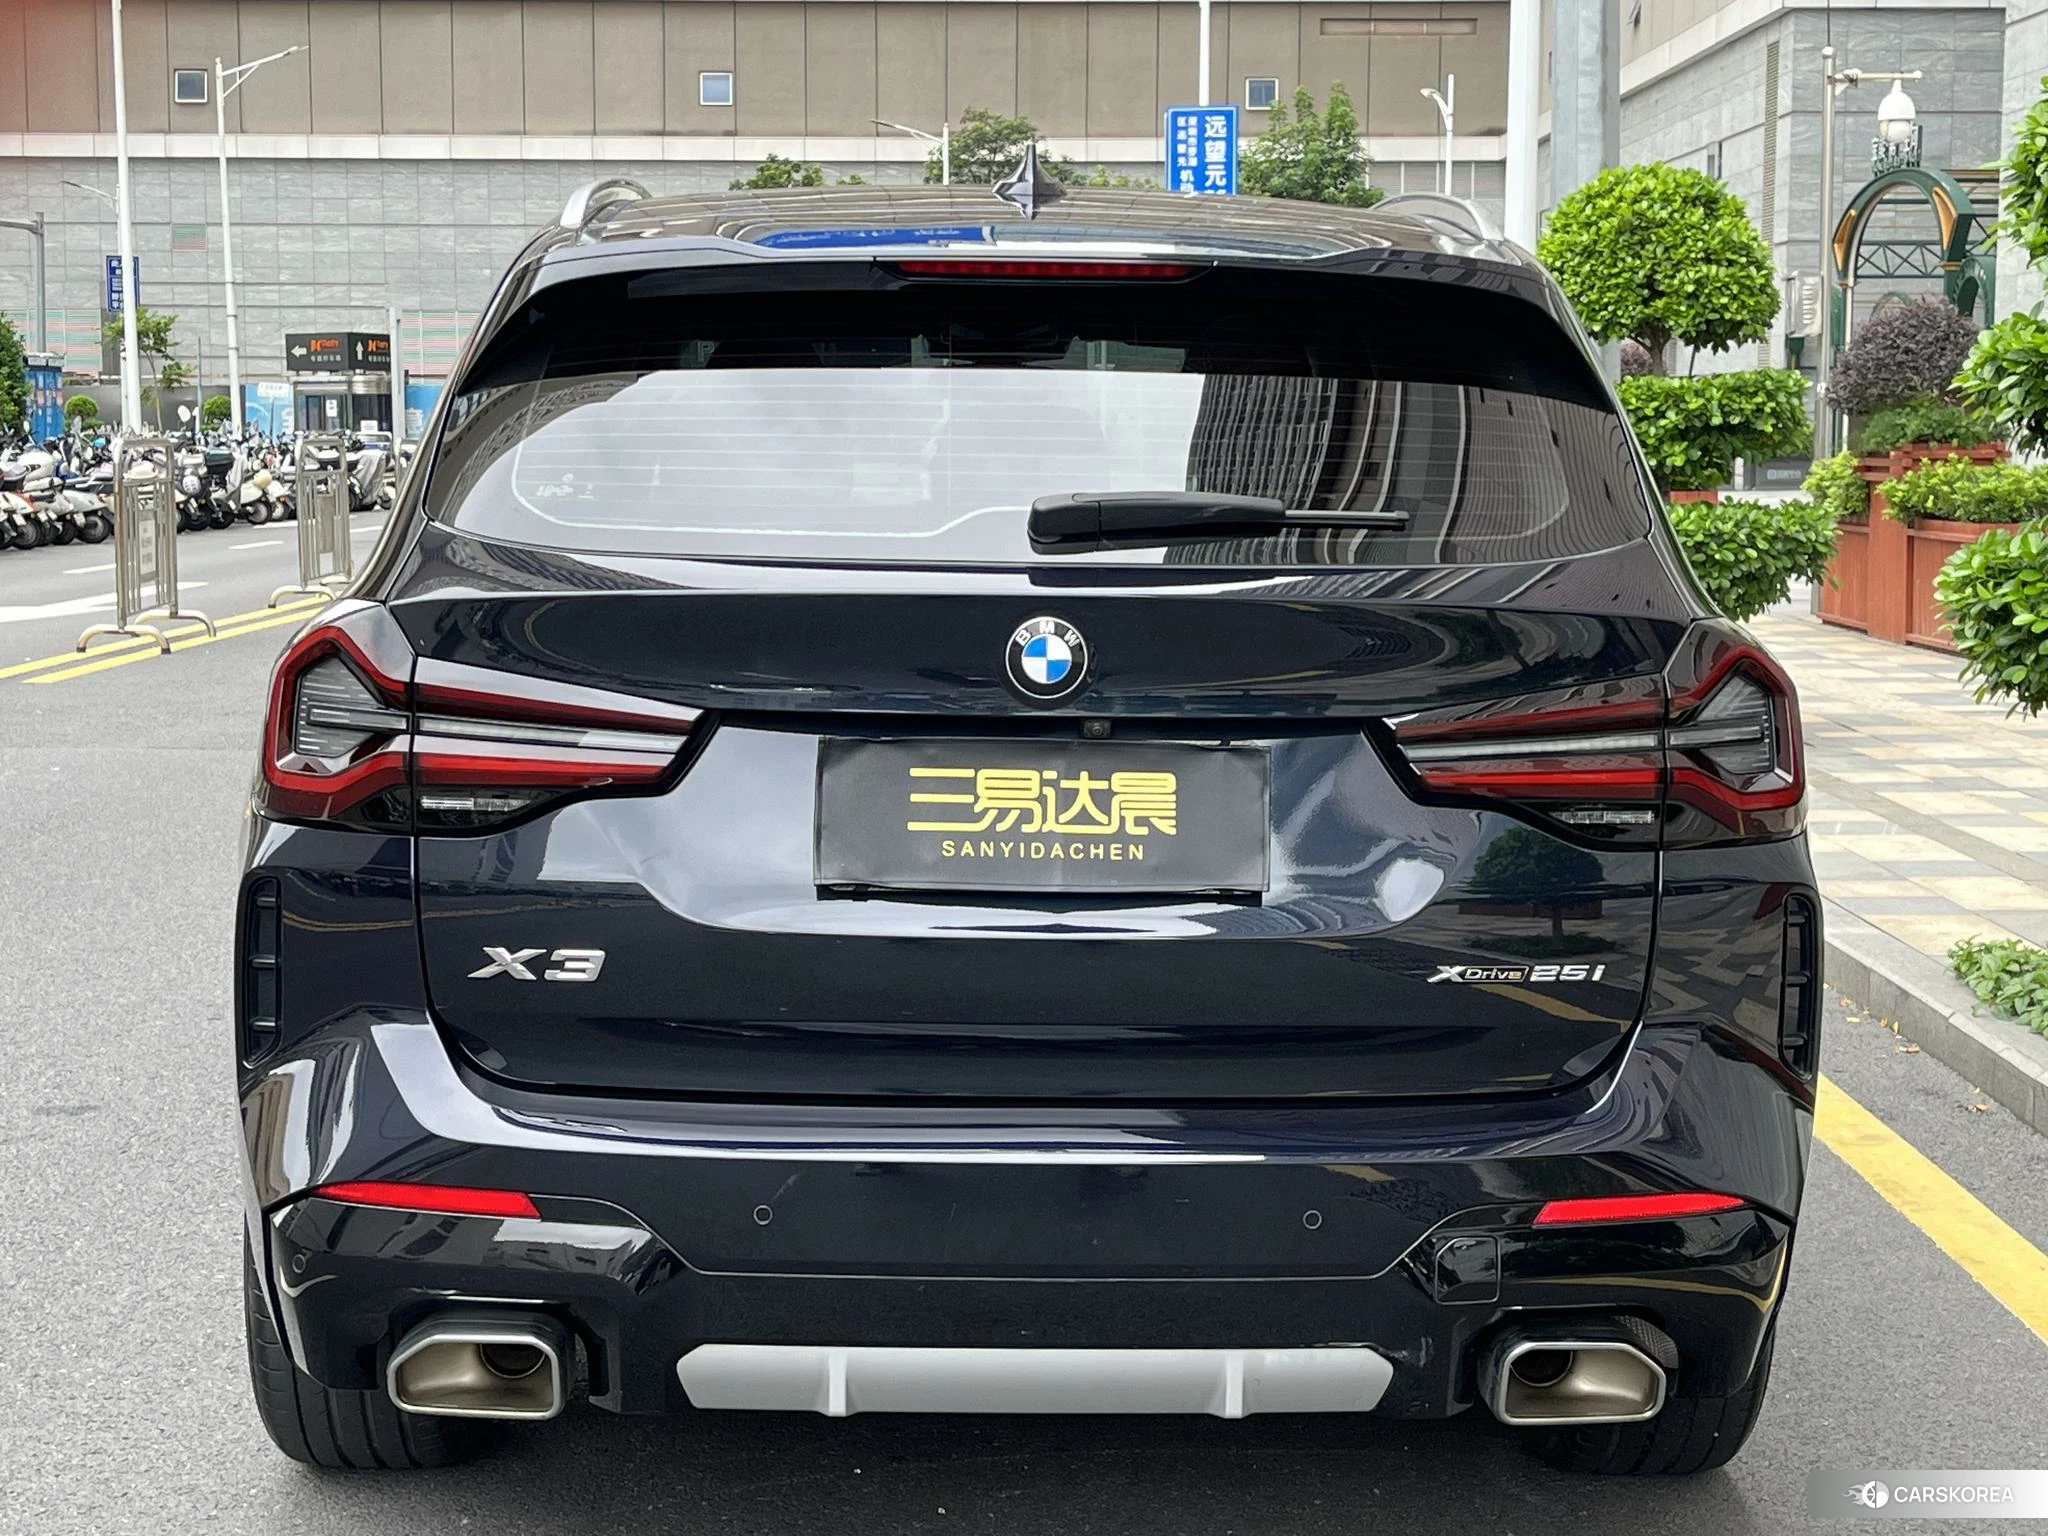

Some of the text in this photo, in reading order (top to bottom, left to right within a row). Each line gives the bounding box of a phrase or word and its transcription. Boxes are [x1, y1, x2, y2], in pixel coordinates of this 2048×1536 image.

[1203, 115, 1227, 194] 远望元
[1015, 620, 1080, 647] BMW
[907, 767, 1177, 836] 三易达晨
[942, 840, 1145, 861] SANYIDACHEN
[467, 946, 606, 982] X3
